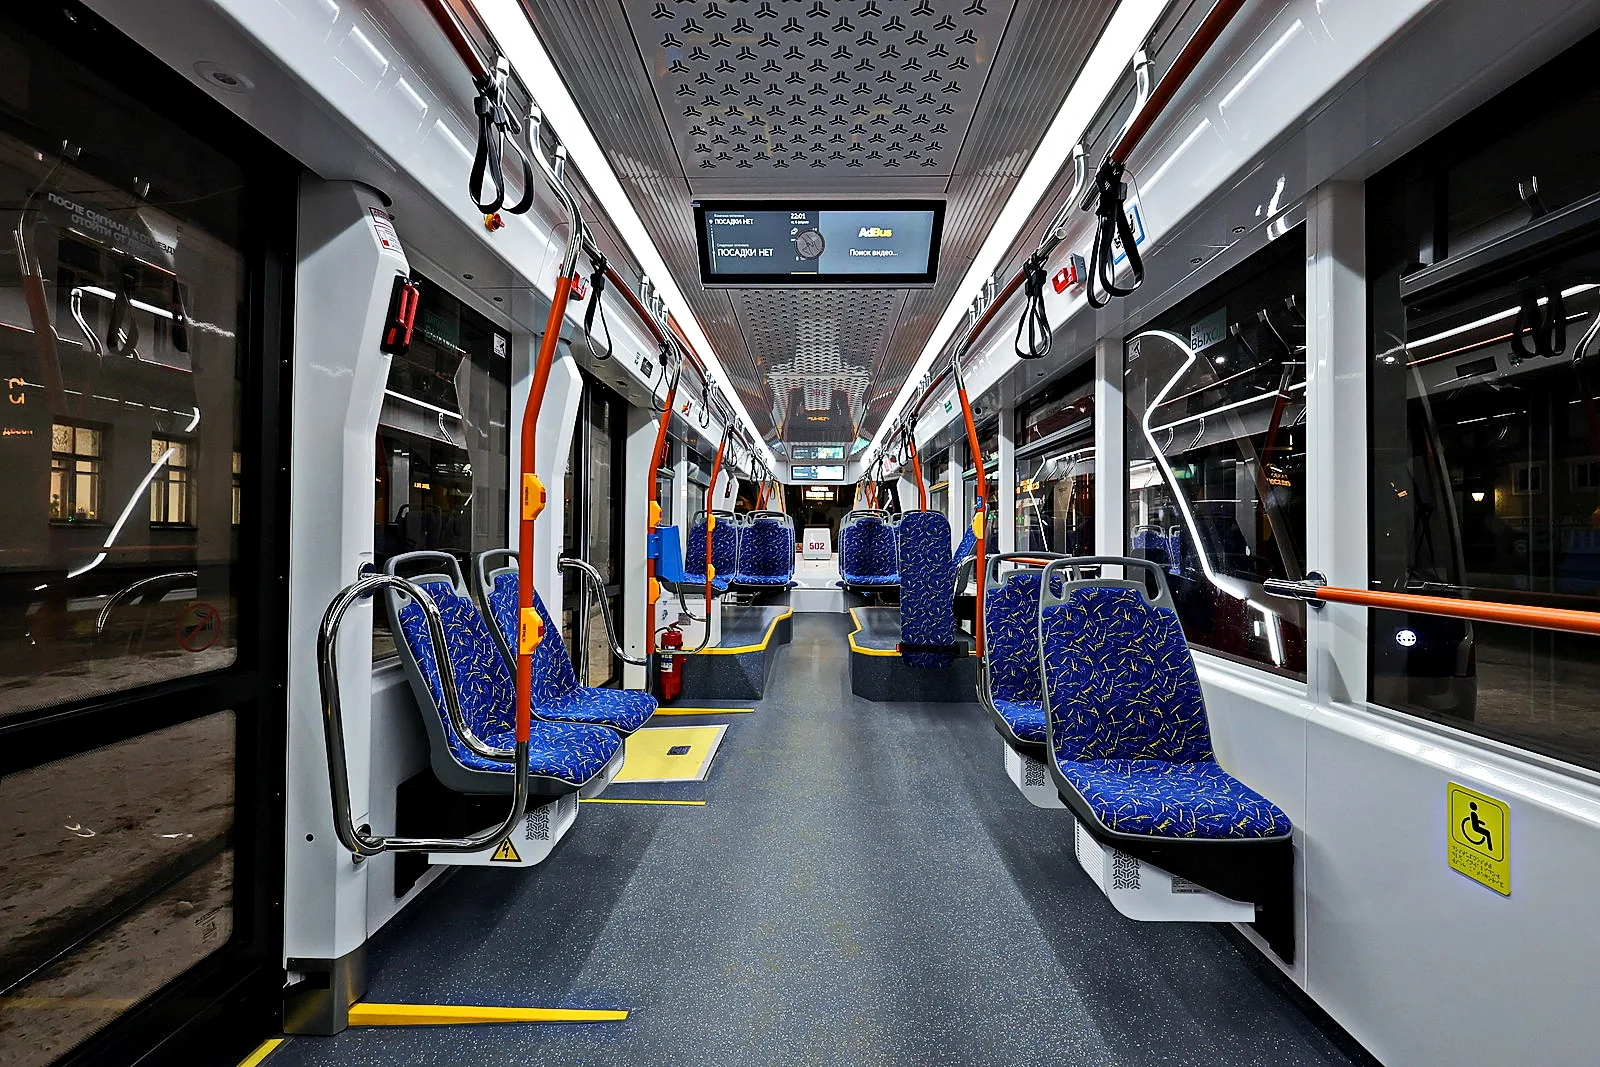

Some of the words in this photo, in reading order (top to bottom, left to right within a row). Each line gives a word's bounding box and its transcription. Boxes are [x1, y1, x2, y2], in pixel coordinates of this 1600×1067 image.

[48, 192, 85, 214] ПОСЛЕ
[858, 227, 893, 238] AdBus
[718, 249, 757, 258] ПОСАДКИ
[758, 249, 774, 257] НЕТ
[809, 542, 825, 550] 502
